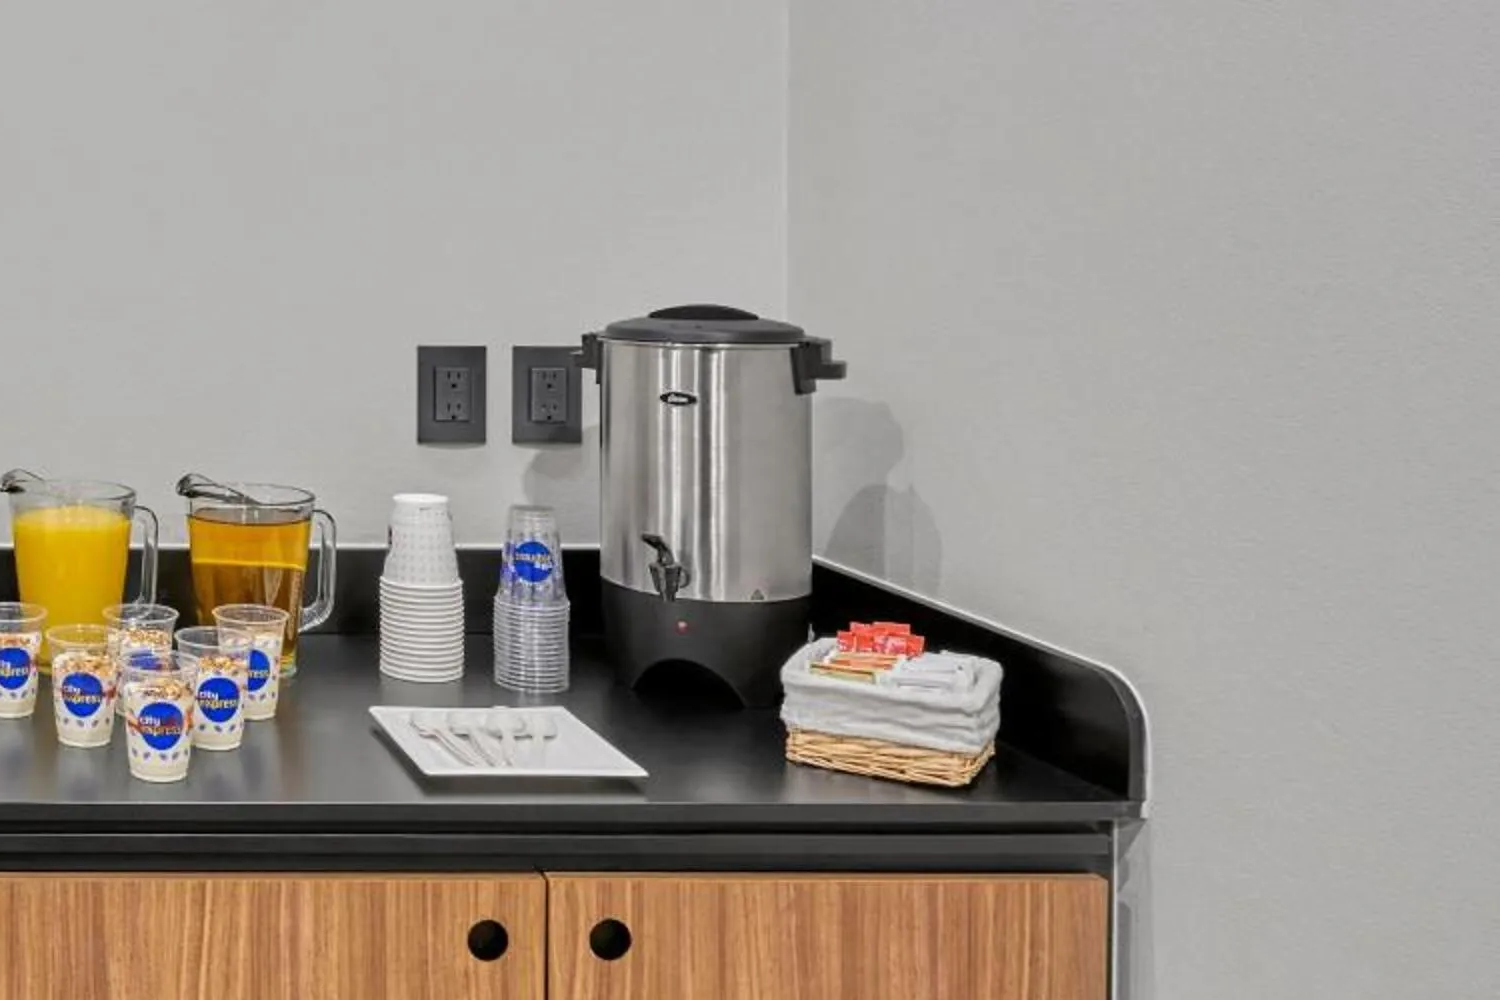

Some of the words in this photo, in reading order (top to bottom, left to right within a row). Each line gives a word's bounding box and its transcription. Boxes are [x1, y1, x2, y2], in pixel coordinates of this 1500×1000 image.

[63, 685, 81, 695] city
[199, 690, 218, 701] city
[63, 694, 102, 705] express
[199, 699, 238, 710] express
[139, 716, 161, 727] city
[140, 726, 182, 736] express
